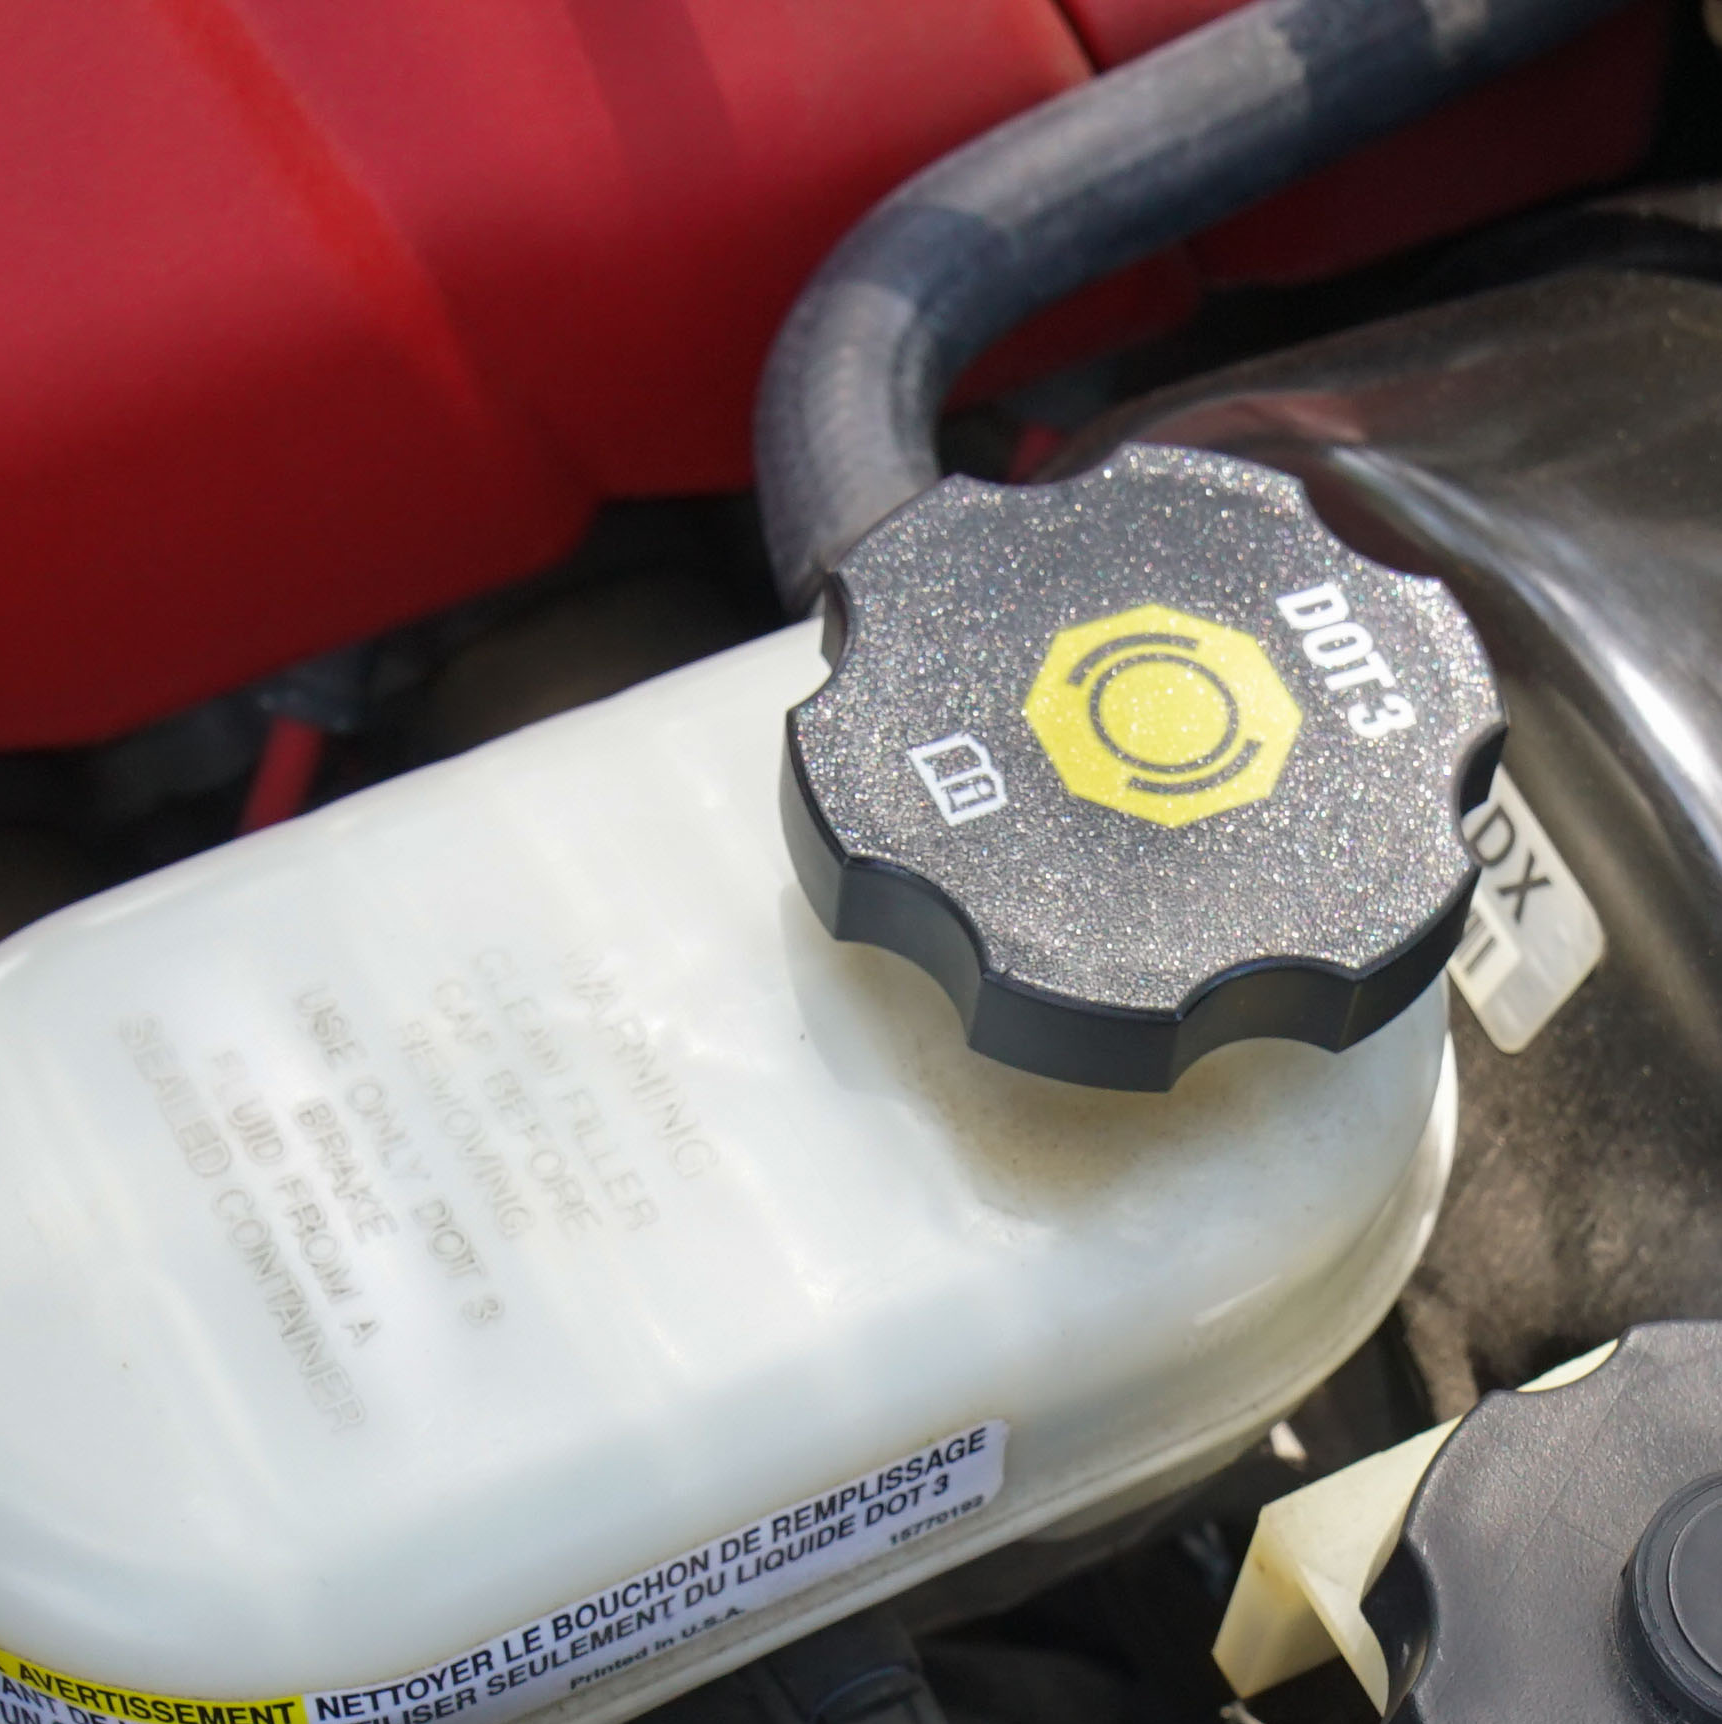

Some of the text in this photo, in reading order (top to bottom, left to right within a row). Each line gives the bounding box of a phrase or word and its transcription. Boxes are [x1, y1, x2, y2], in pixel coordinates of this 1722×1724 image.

[1276, 580, 1419, 740] DOT 3
[292, 980, 506, 1329] USE ONLY DOT 3
[293, 1098, 399, 1244] BRAKE
[396, 1018, 536, 1242] REMOVING
[430, 977, 604, 1241] CAP BEFORE
[470, 944, 661, 1233] CLEAN FILLER
[553, 936, 720, 1181] WARNING
[118, 1010, 369, 1435] SEALED CONTAINER
[275, 1176, 361, 1307] FROM
[345, 1315, 383, 1349] A
[315, 1650, 494, 1721] NETTOYER
[504, 1626, 545, 1664] LE
[552, 1549, 711, 1642] BOUCHON
[721, 1526, 762, 1565] DE
[771, 1426, 987, 1542] REMPLISSAGE
[487, 1600, 676, 1698] SEULEMENT
[684, 1573, 726, 1609] DU
[736, 1514, 855, 1585] LIQUIDE
[866, 1483, 926, 1528] DOT
[932, 1473, 950, 1497] 3
[570, 1605, 745, 1691] Printed in U.S.A.
